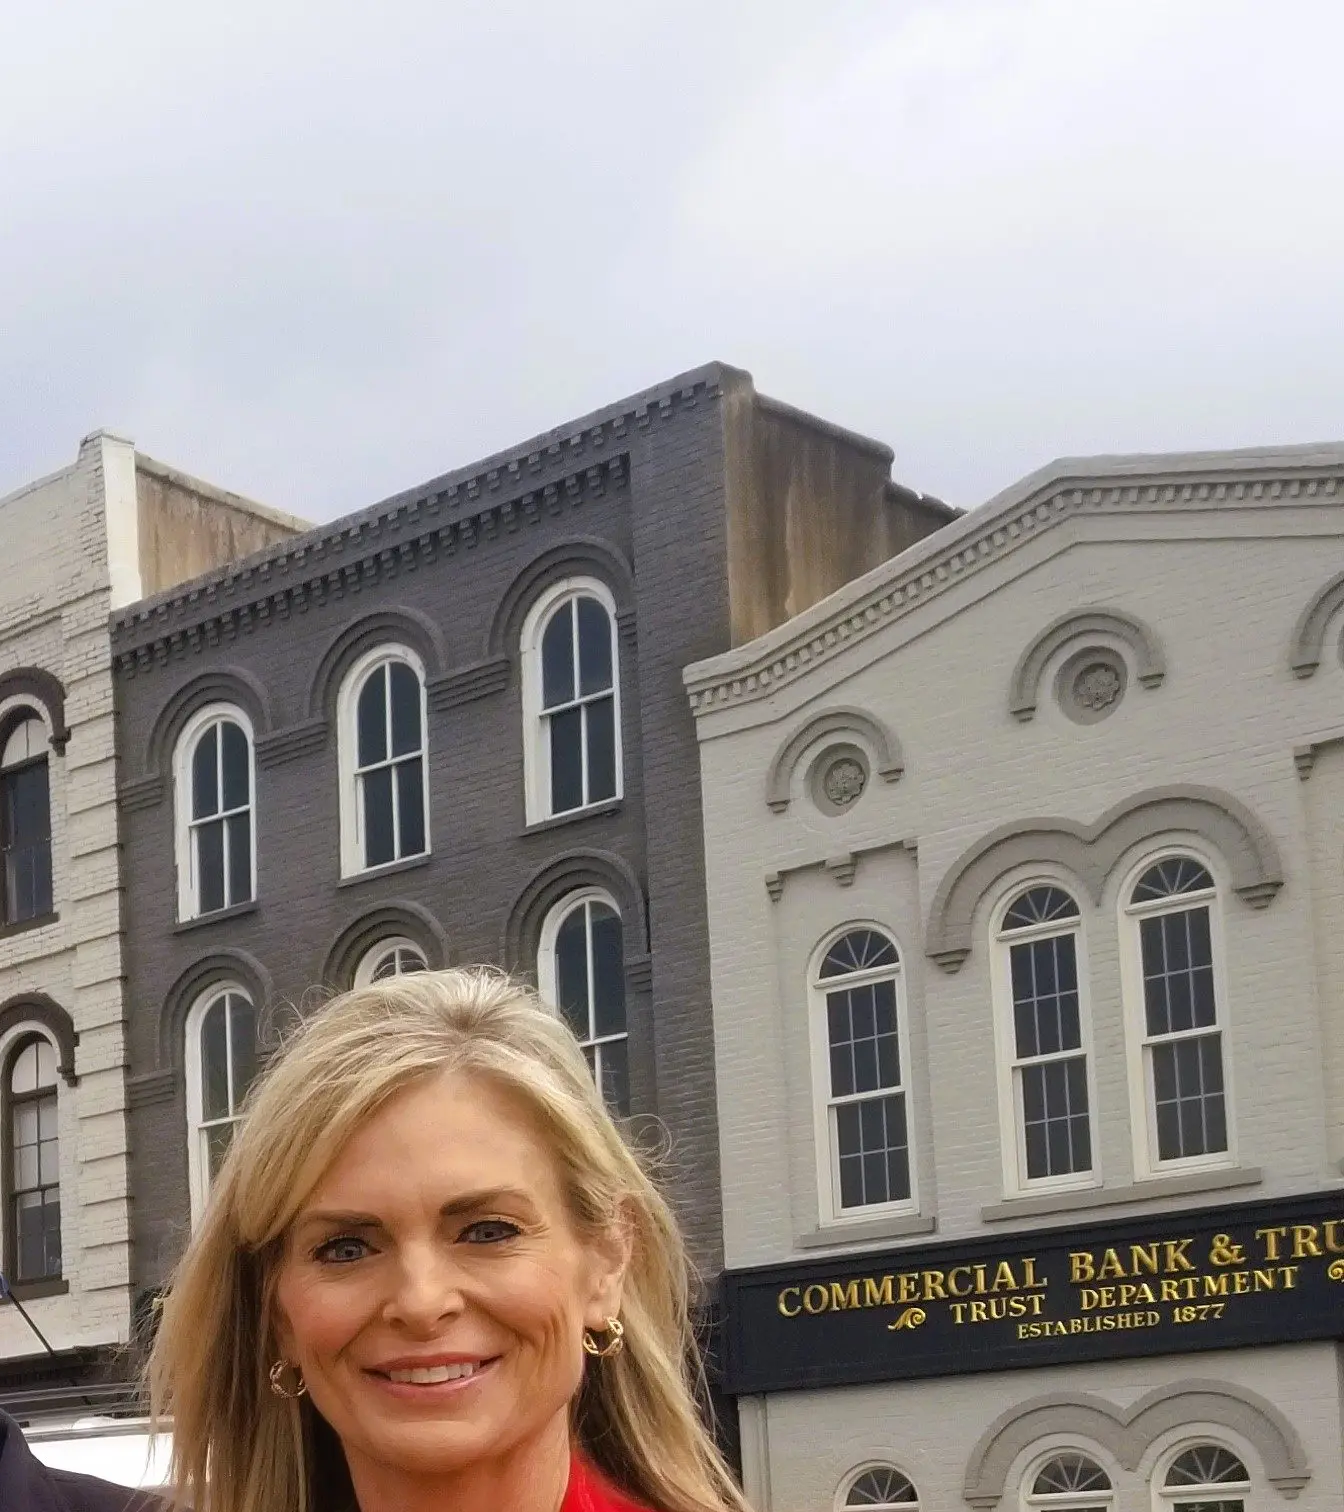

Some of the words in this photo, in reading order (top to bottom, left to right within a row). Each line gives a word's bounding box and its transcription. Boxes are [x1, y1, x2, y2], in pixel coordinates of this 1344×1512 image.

[777, 1257, 1048, 1319] COMMERCIAL
[1069, 1238, 1198, 1285] BANK
[1208, 1232, 1246, 1266] &
[950, 1294, 1045, 1326] TRUST
[1080, 1266, 1301, 1311] DEPARTMENT
[1017, 1310, 1161, 1341] ESTABLISHED
[1172, 1302, 1226, 1323] 1877
